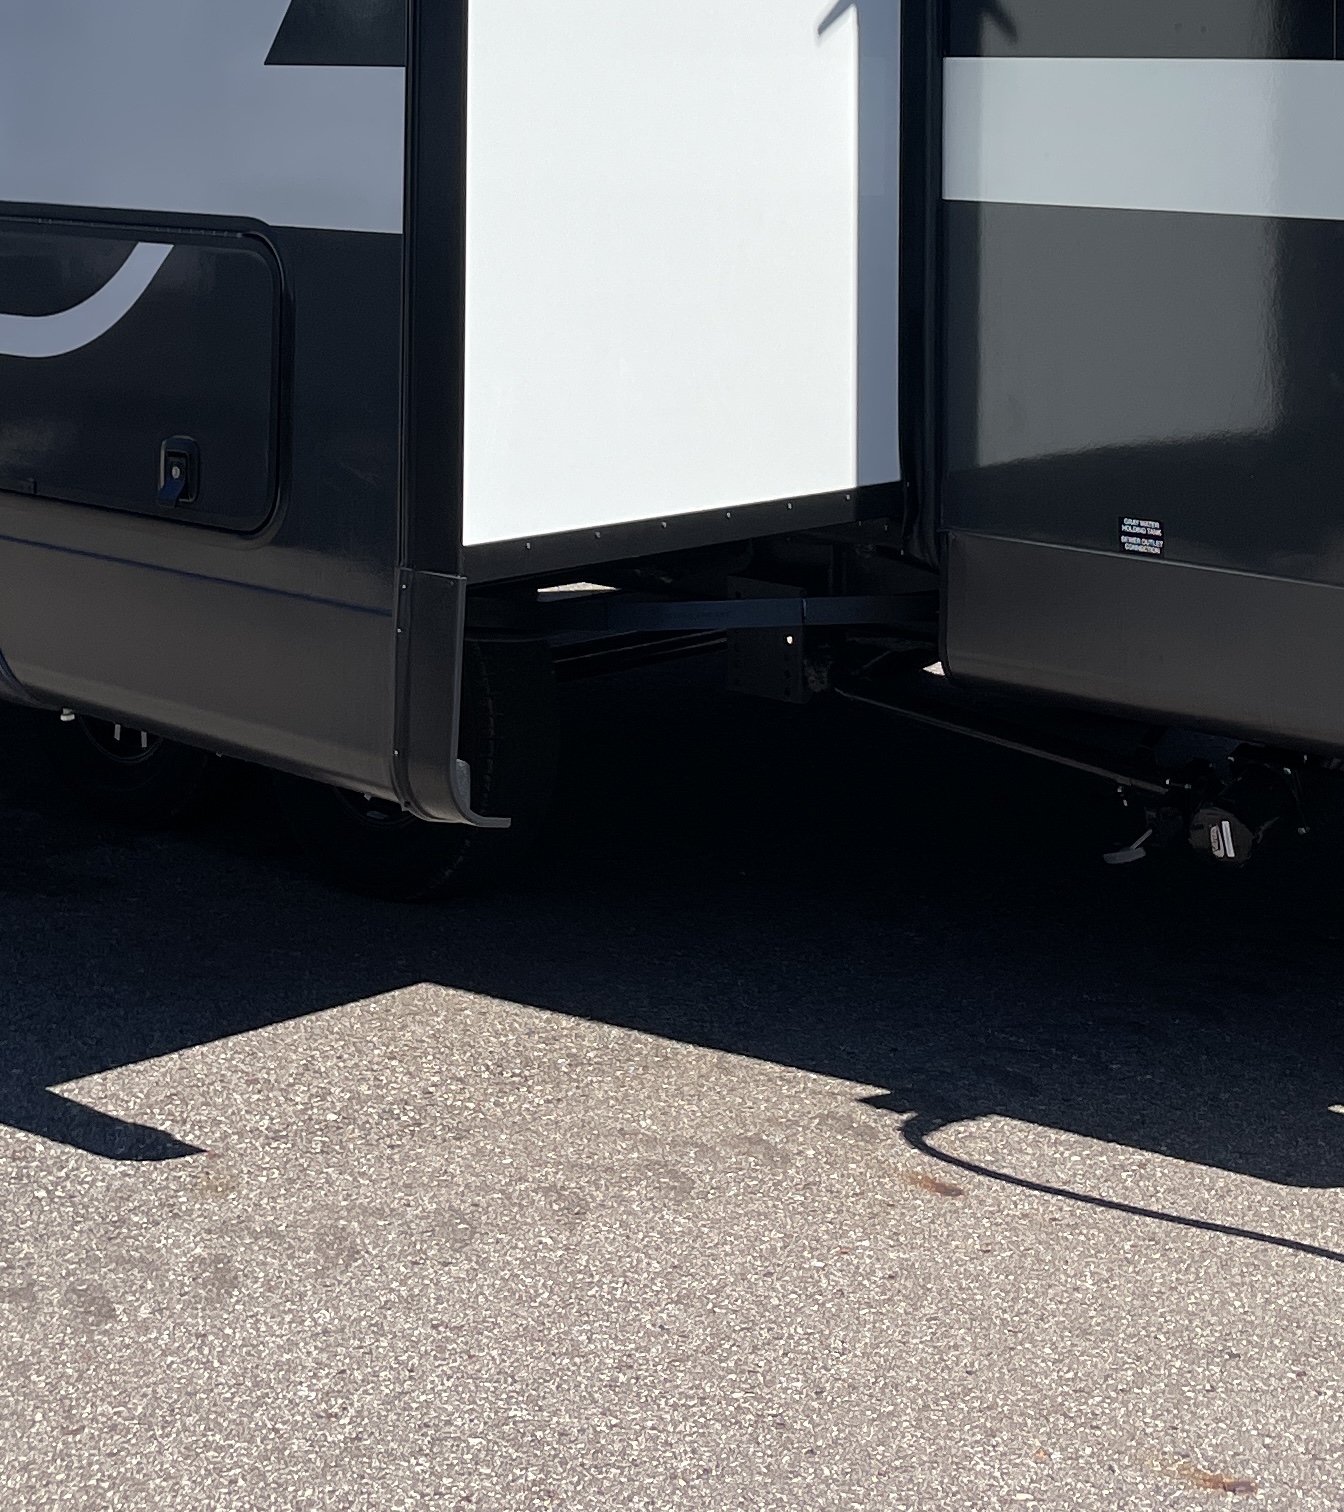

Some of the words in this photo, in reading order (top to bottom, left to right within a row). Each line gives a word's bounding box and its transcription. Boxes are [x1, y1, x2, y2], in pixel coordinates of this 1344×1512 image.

[1121, 524, 1147, 534] HOLDING
[1147, 527, 1162, 537] TANK
[1140, 520, 1160, 529] WATER
[1121, 535, 1141, 544] SEWER
[1141, 538, 1164, 548] OUTLET
[1124, 543, 1161, 554] CONNECTION
